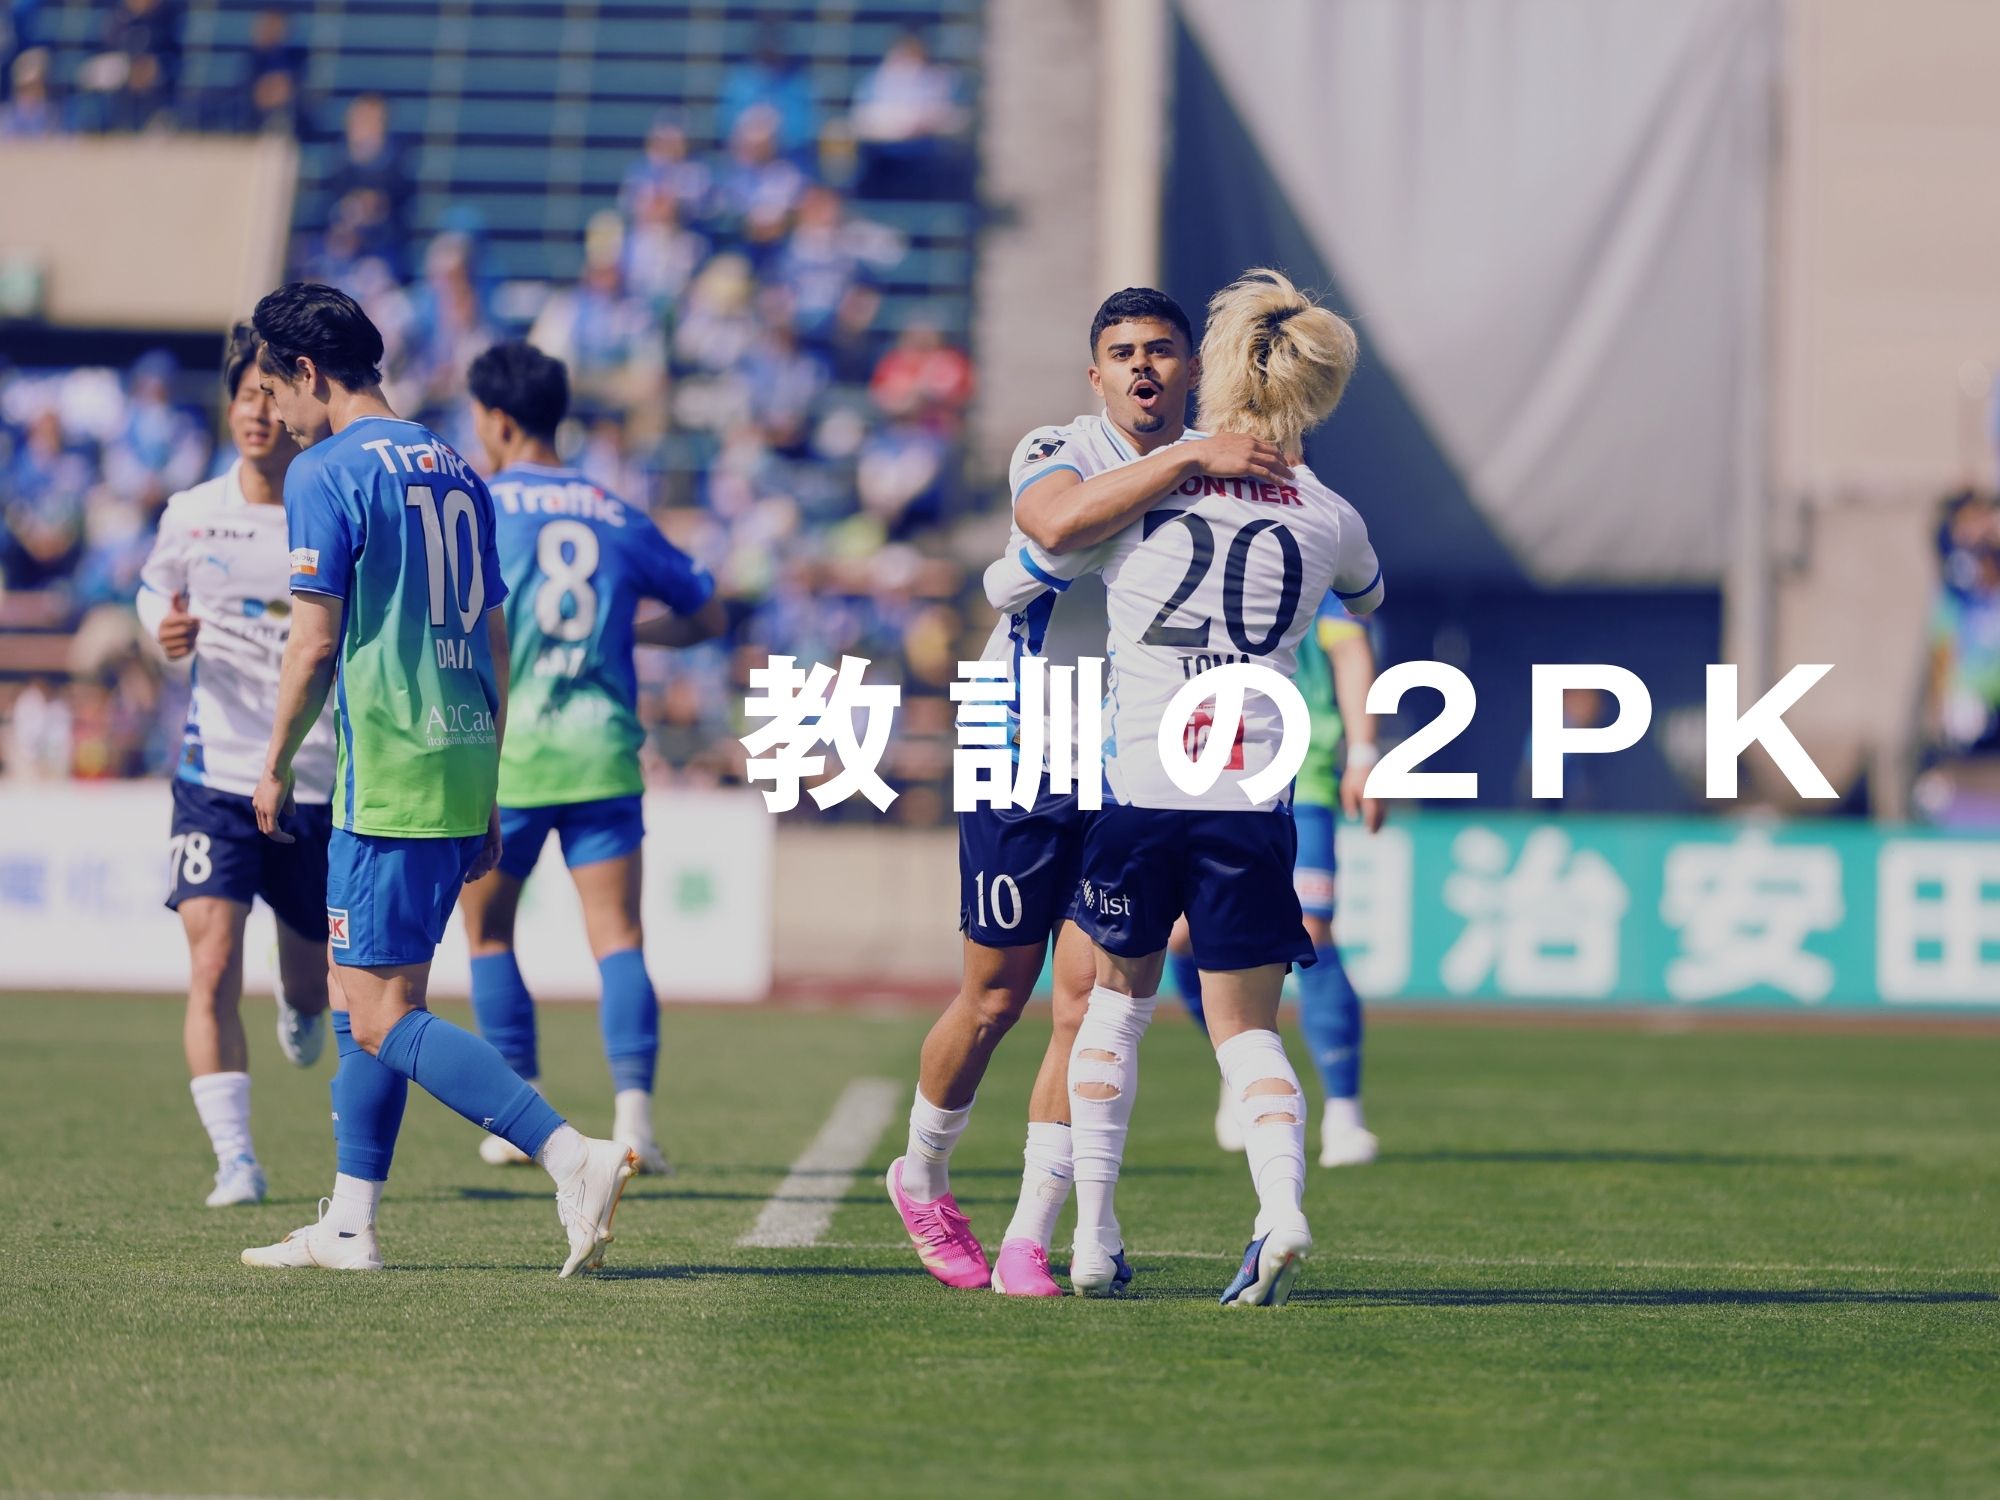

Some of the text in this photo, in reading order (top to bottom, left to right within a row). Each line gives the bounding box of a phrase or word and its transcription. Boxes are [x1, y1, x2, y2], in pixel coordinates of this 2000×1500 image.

[1170, 475, 1303, 506] ONTIER
[405, 484, 486, 635] 10
[535, 518, 600, 643] 8
[1136, 509, 1303, 656] 20
[170, 831, 213, 891] 78
[975, 870, 1023, 930] 10
[1099, 888, 1131, 916] list
